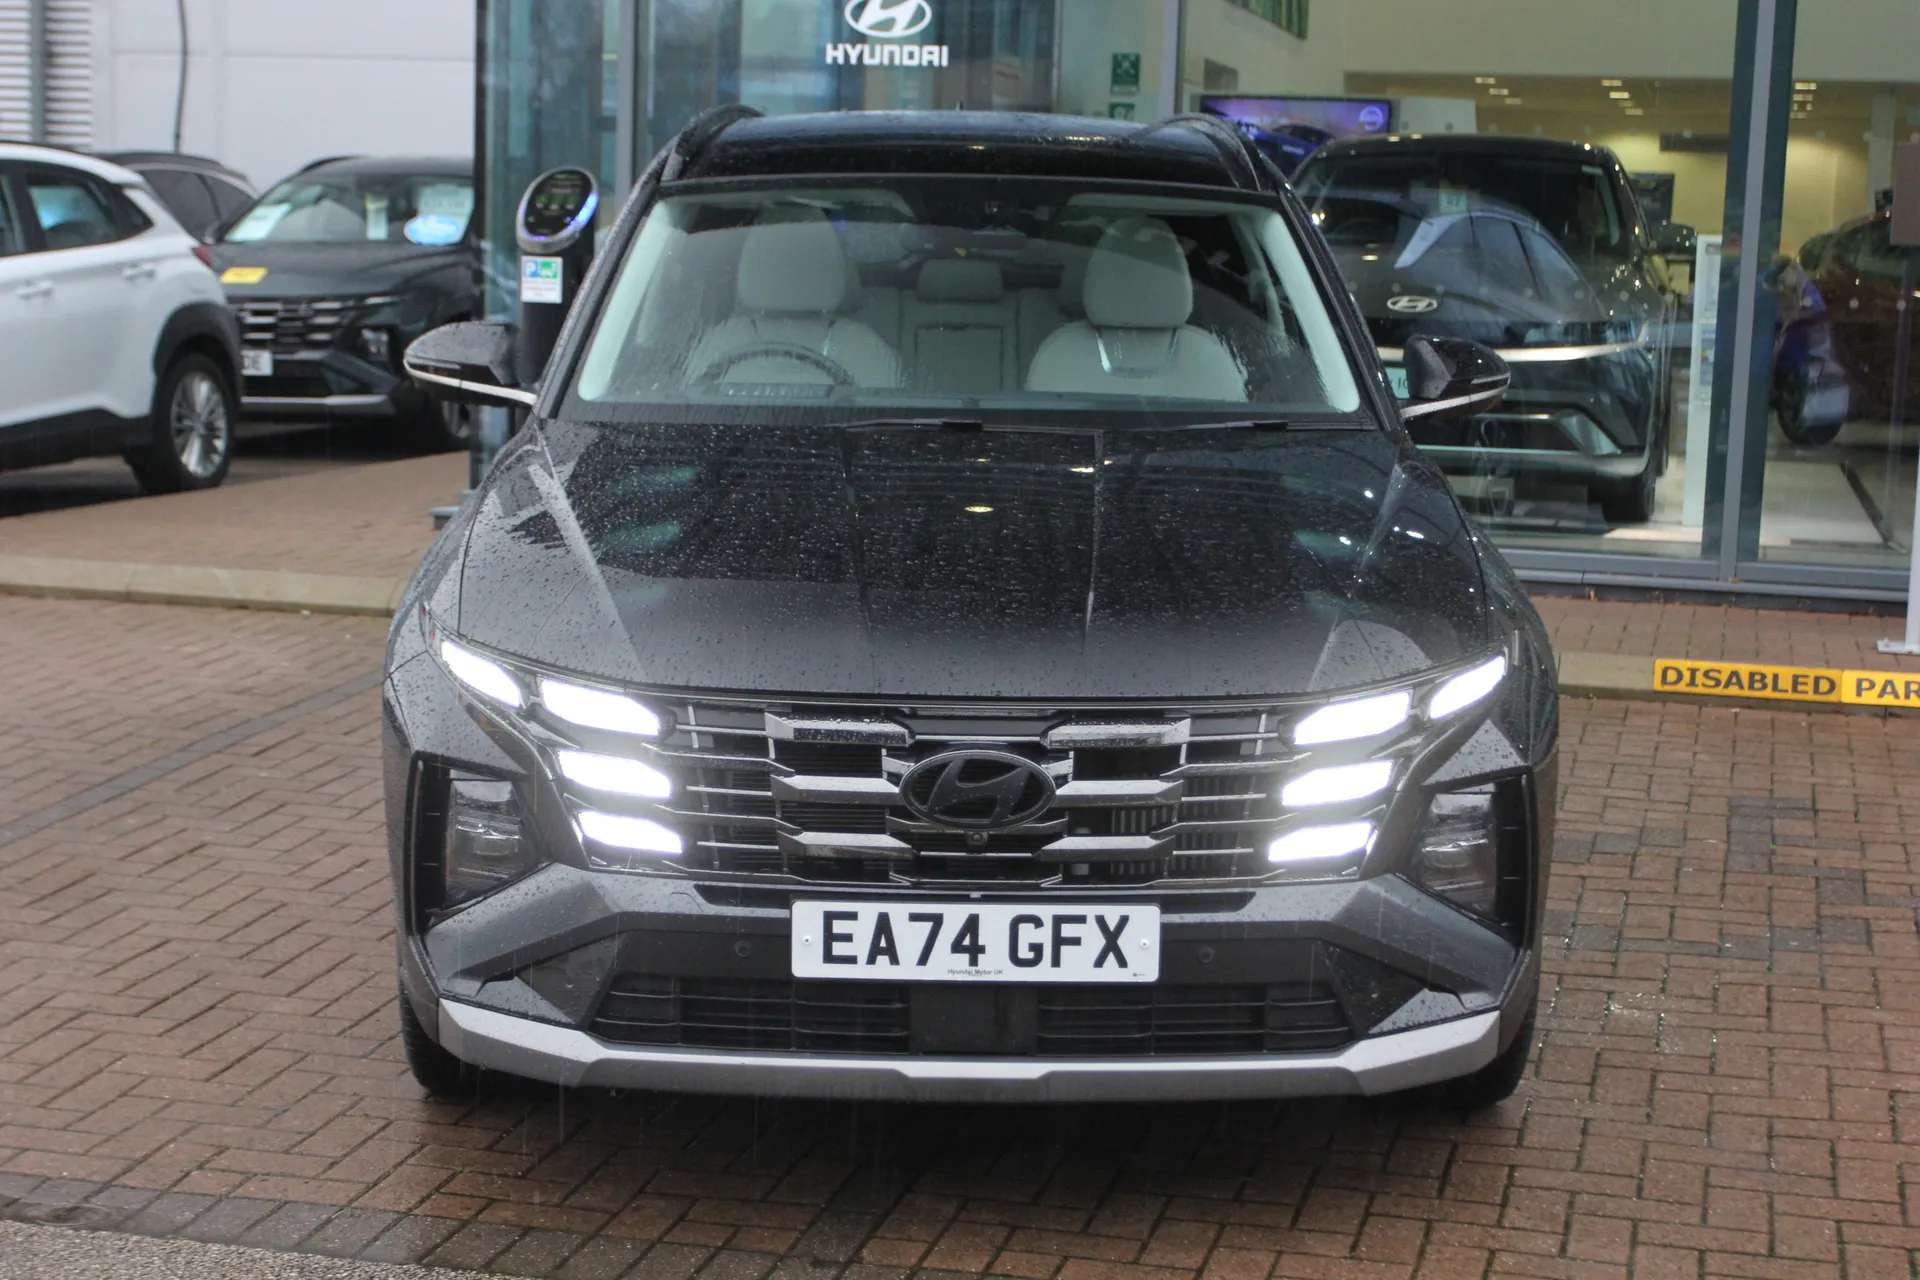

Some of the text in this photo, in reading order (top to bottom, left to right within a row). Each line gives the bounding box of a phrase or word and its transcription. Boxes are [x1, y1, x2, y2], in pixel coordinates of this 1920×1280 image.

[825, 43, 949, 67] HYUNDAI
[1660, 666, 1836, 696] DISABLED
[822, 910, 1130, 968] EA74 GFX
